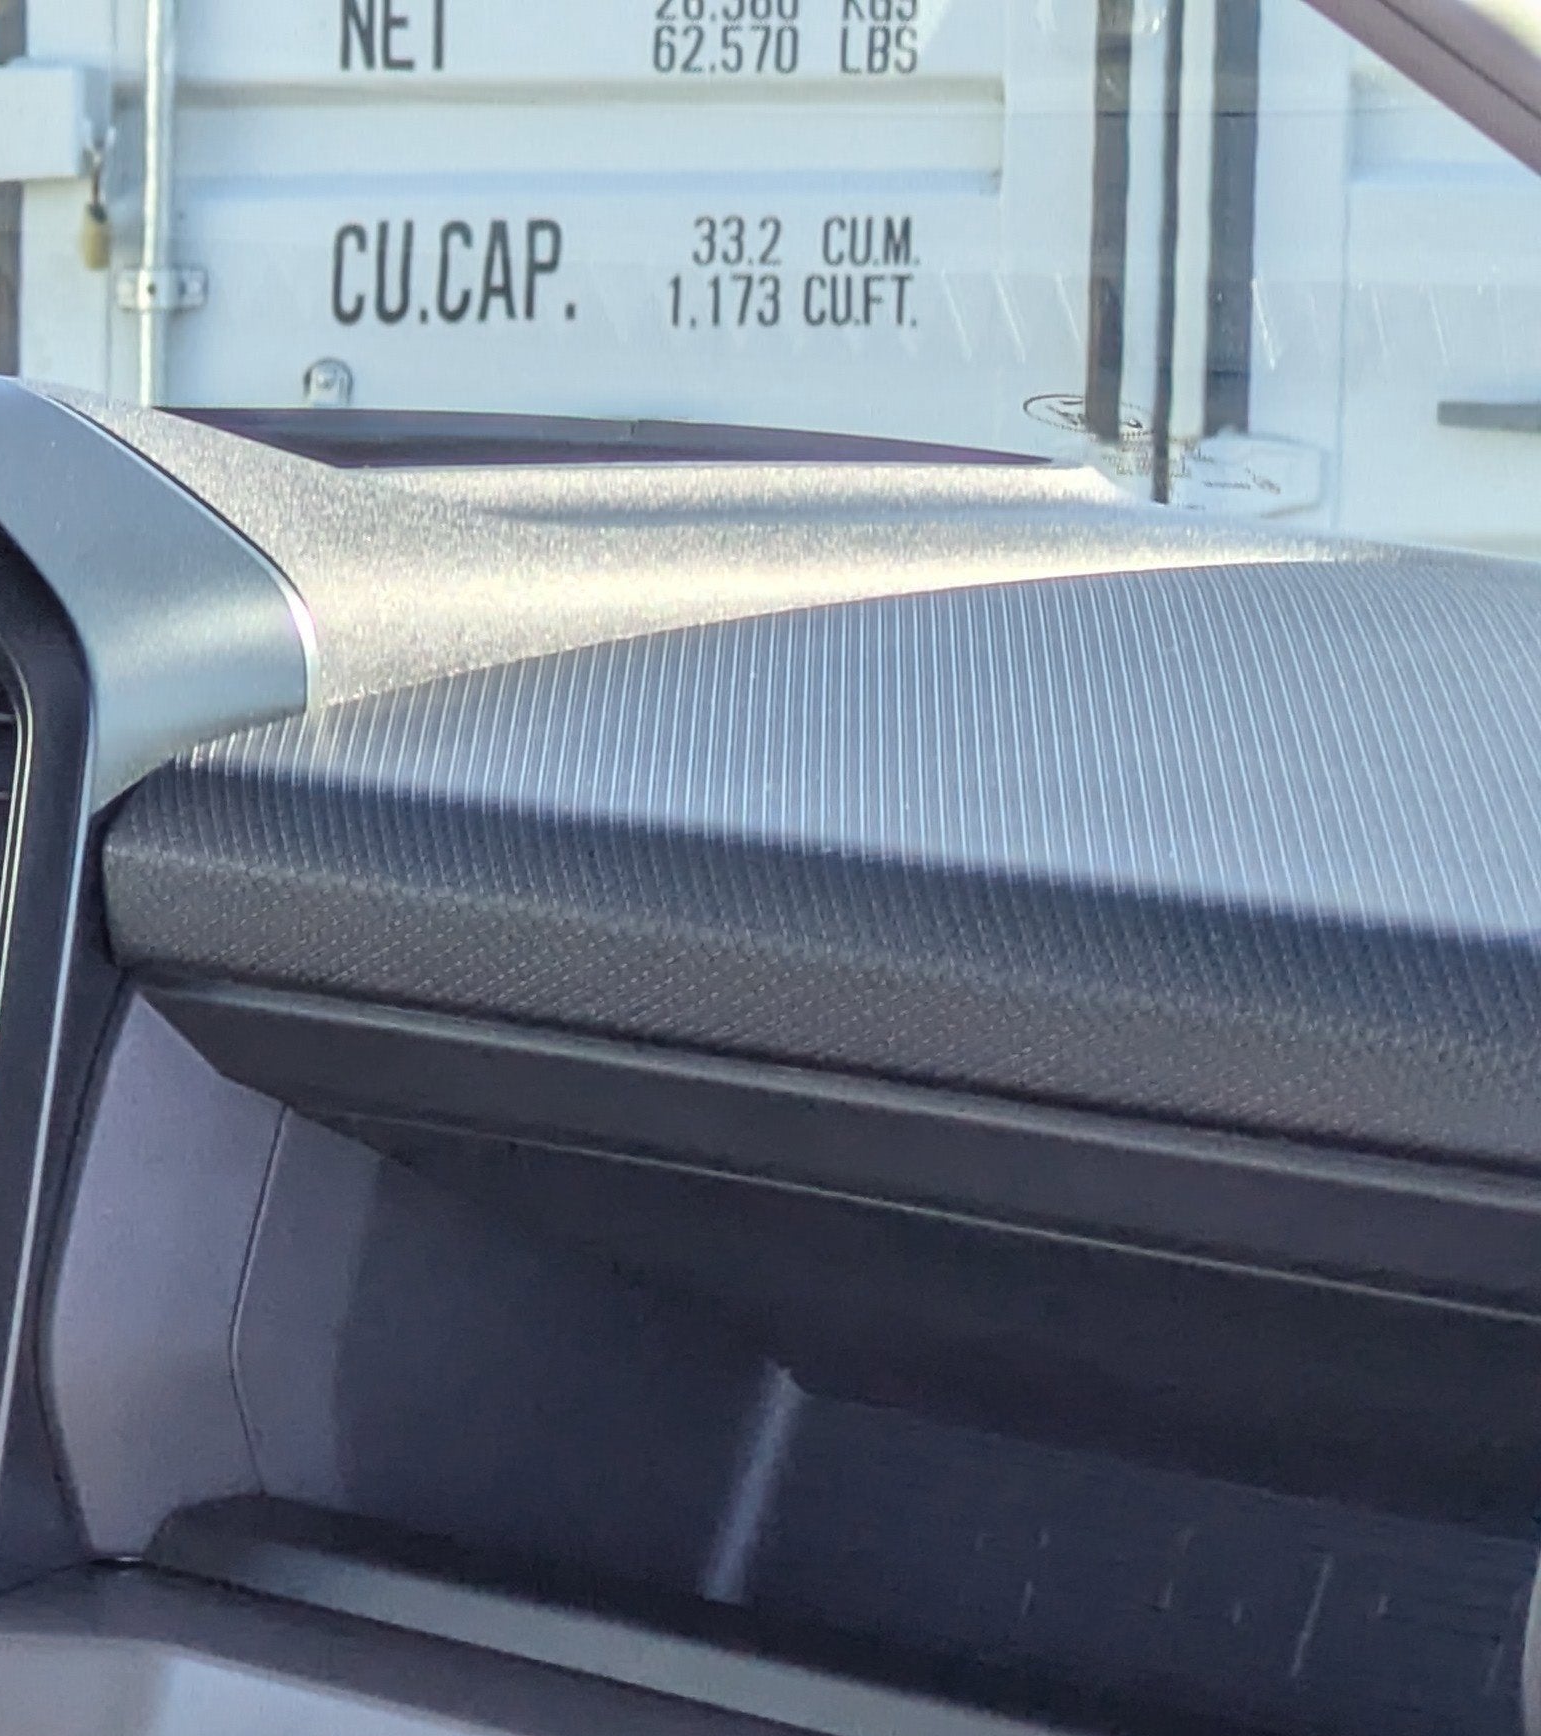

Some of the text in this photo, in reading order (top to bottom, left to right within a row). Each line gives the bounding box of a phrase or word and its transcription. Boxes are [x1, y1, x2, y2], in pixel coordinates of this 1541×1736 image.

[652, 24, 919, 75] 62.570 LBS
[692, 216, 920, 267] 33.2 CU.M.
[330, 218, 578, 326] CU.CAP.
[666, 272, 919, 329] 1.173 CU.FT.
